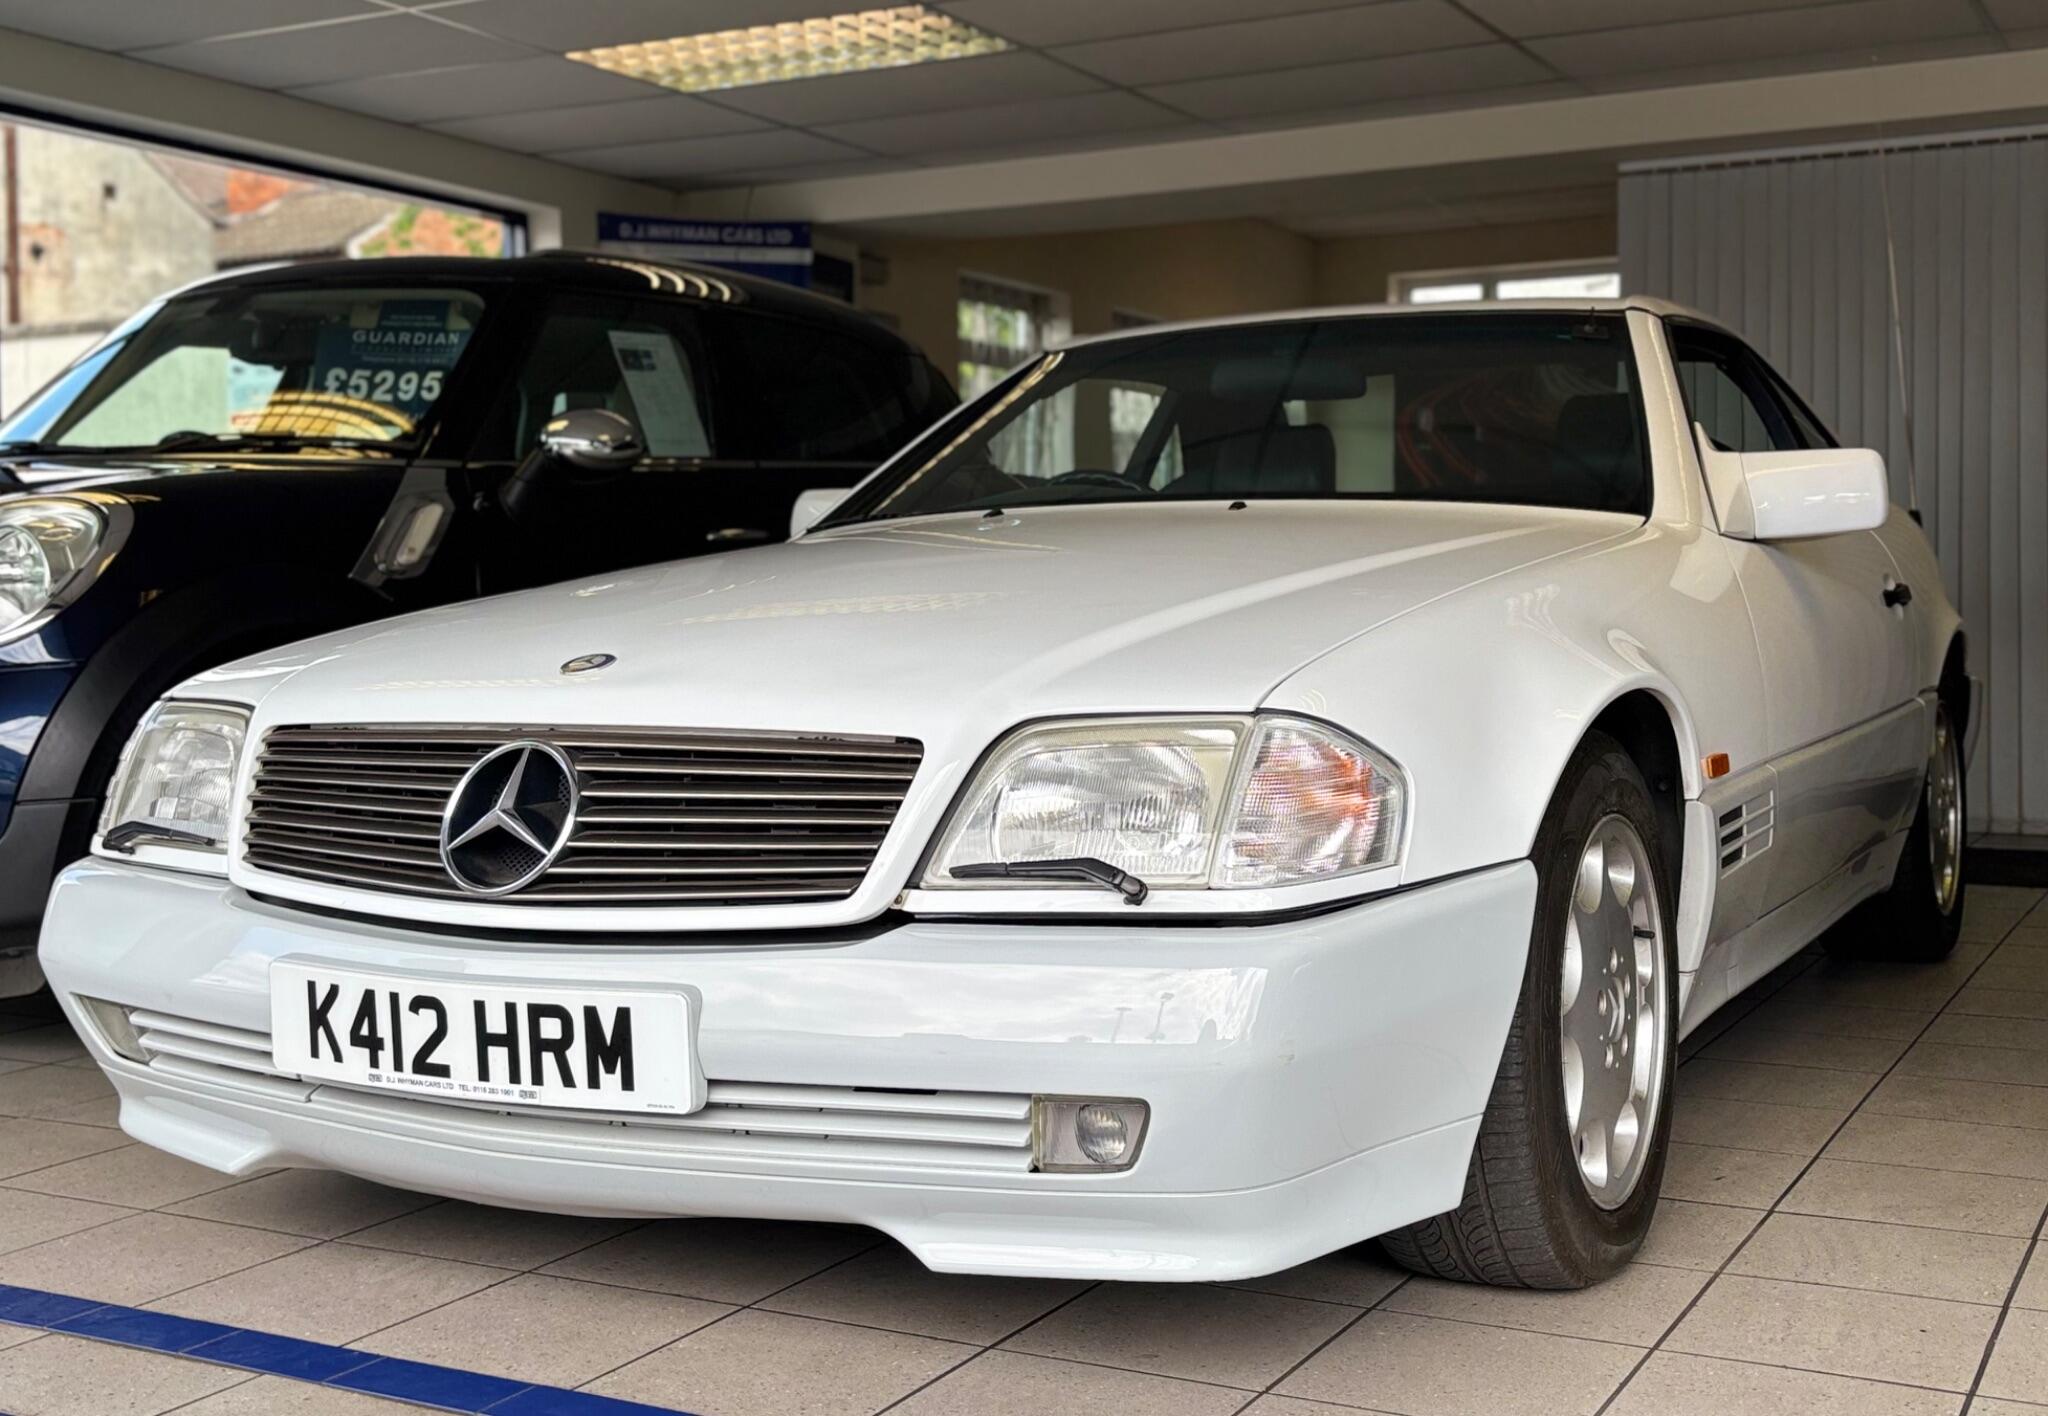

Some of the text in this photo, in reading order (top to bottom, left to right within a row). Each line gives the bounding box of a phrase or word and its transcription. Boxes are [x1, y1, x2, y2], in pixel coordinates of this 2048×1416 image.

[722, 225, 763, 244] CARS
[766, 228, 793, 244] LTD
[352, 330, 460, 345] GUARDIAN
[325, 367, 443, 401] £5295
[307, 980, 635, 1091] K412 HRM
[425, 1081, 441, 1089] CARS
[442, 1082, 455, 1090] LTD
